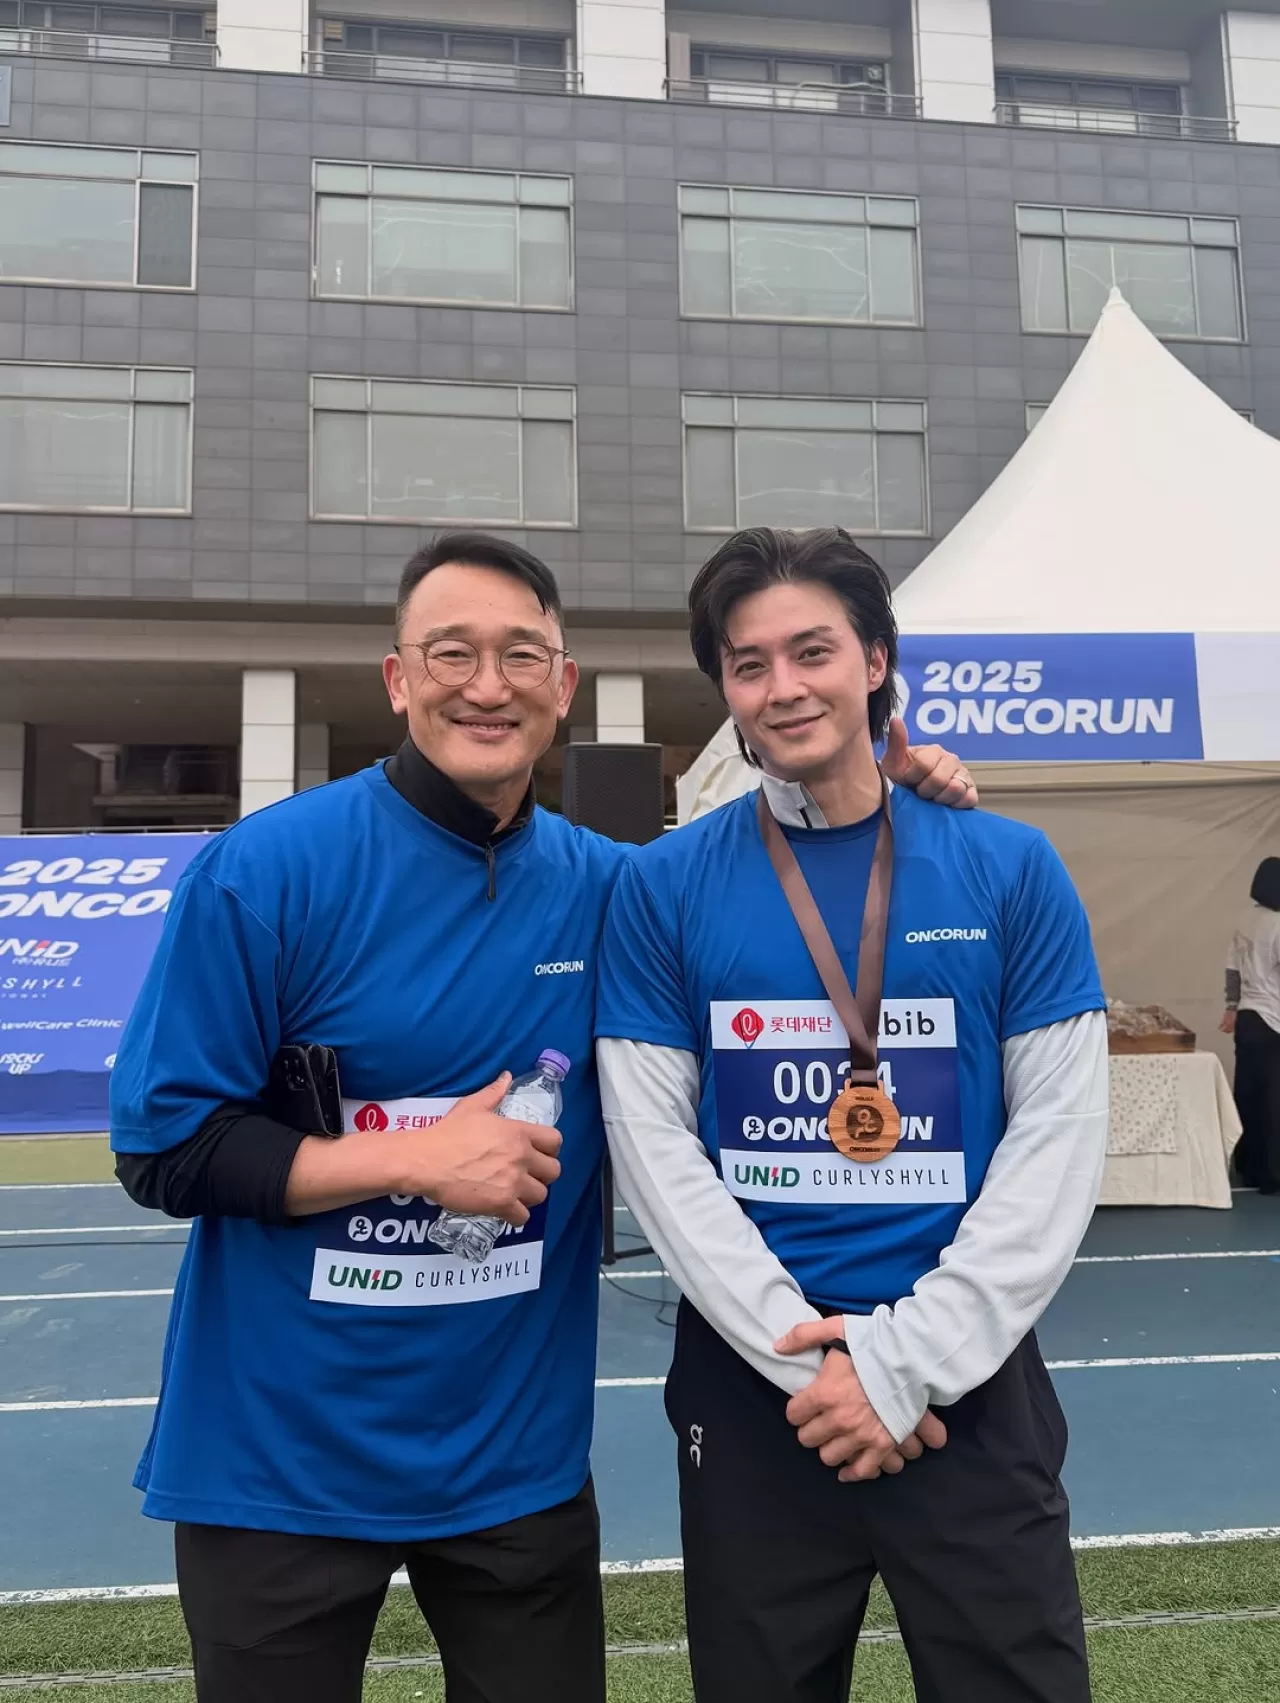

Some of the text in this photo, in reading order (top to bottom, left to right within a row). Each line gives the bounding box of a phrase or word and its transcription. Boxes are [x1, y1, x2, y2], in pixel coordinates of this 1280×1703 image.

[922, 660, 1043, 693] 2025
[916, 698, 1174, 735] ONCORUN
[0, 857, 168, 886] 2025
[0, 889, 173, 919] ONCO
[905, 928, 987, 943] ONCORUN
[0, 938, 79, 958] NID
[534, 960, 584, 975] ONCORUN
[0, 976, 82, 989] SHYLL
[770, 1016, 833, 1033] 롯데재단
[877, 1011, 935, 1035] bib
[395, 1114, 443, 1131] 롯데재
[813, 1169, 949, 1185] CURLYSHYLL
[415, 1259, 531, 1288] CURLYSHYLL
